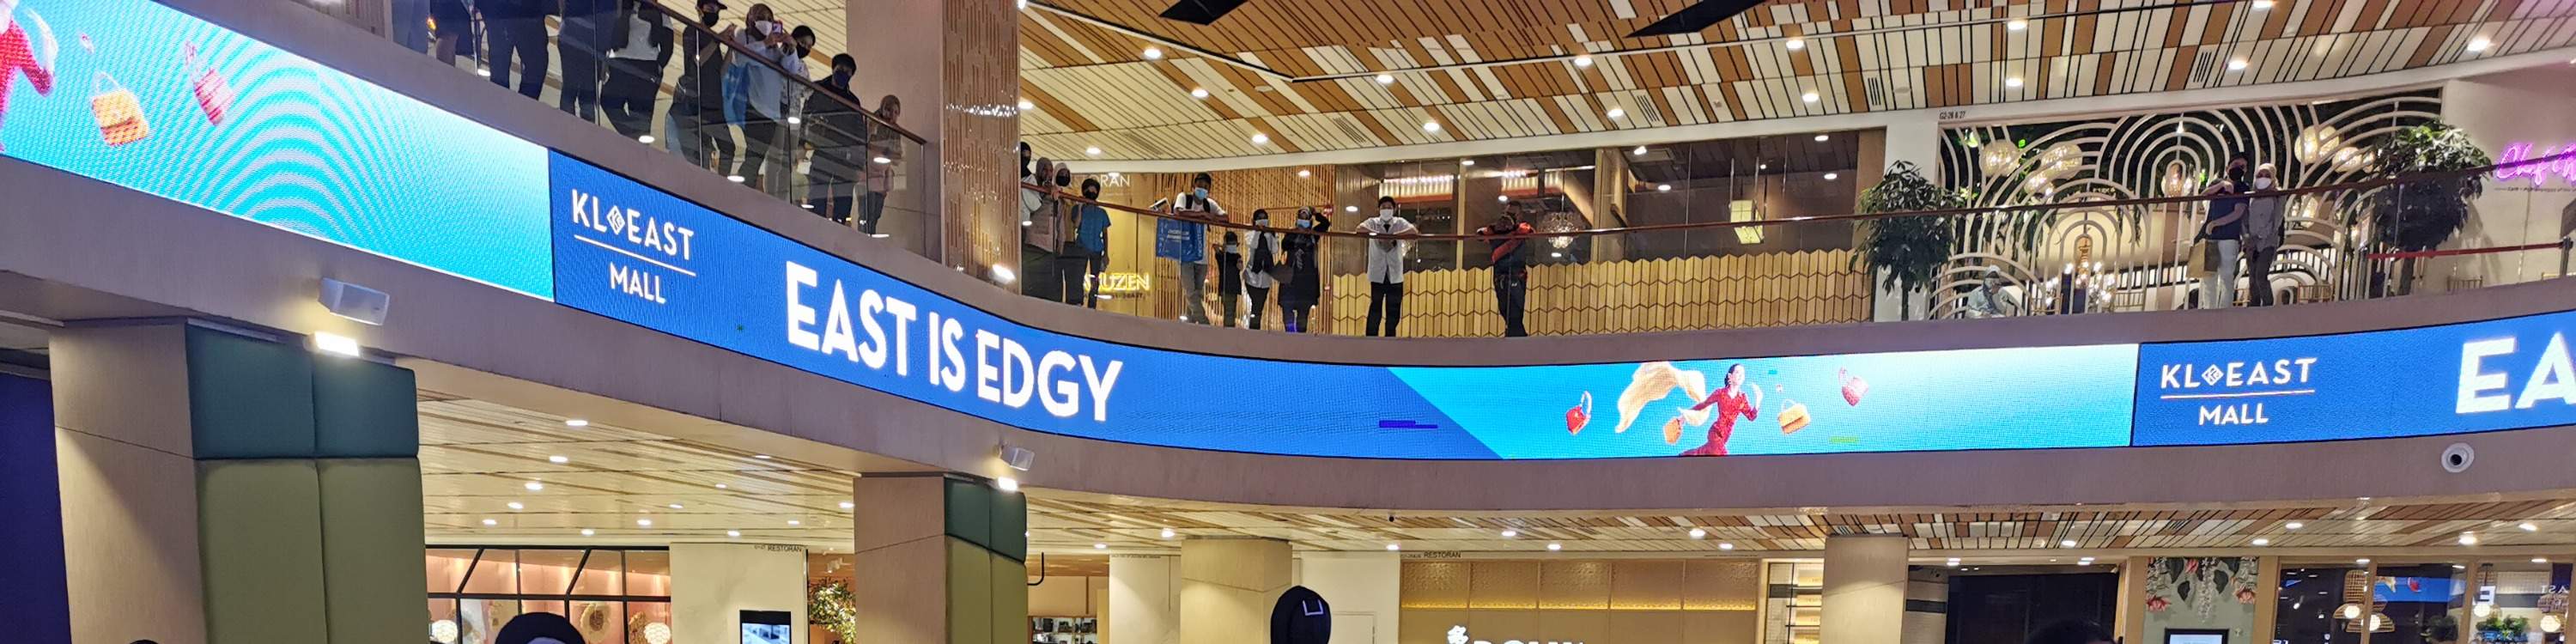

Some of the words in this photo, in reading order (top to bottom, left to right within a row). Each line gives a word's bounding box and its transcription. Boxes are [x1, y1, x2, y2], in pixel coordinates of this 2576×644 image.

[572, 188, 608, 233] KL
[627, 208, 695, 261] EAST
[610, 261, 666, 304] MALL
[786, 260, 917, 377] EAST
[929, 311, 967, 392] IS
[976, 328, 1124, 422] EDGY
[2160, 363, 2201, 389] KL
[2226, 357, 2318, 387] EAST
[2456, 331, 2576, 414] EA
[2198, 402, 2269, 426] MALL
